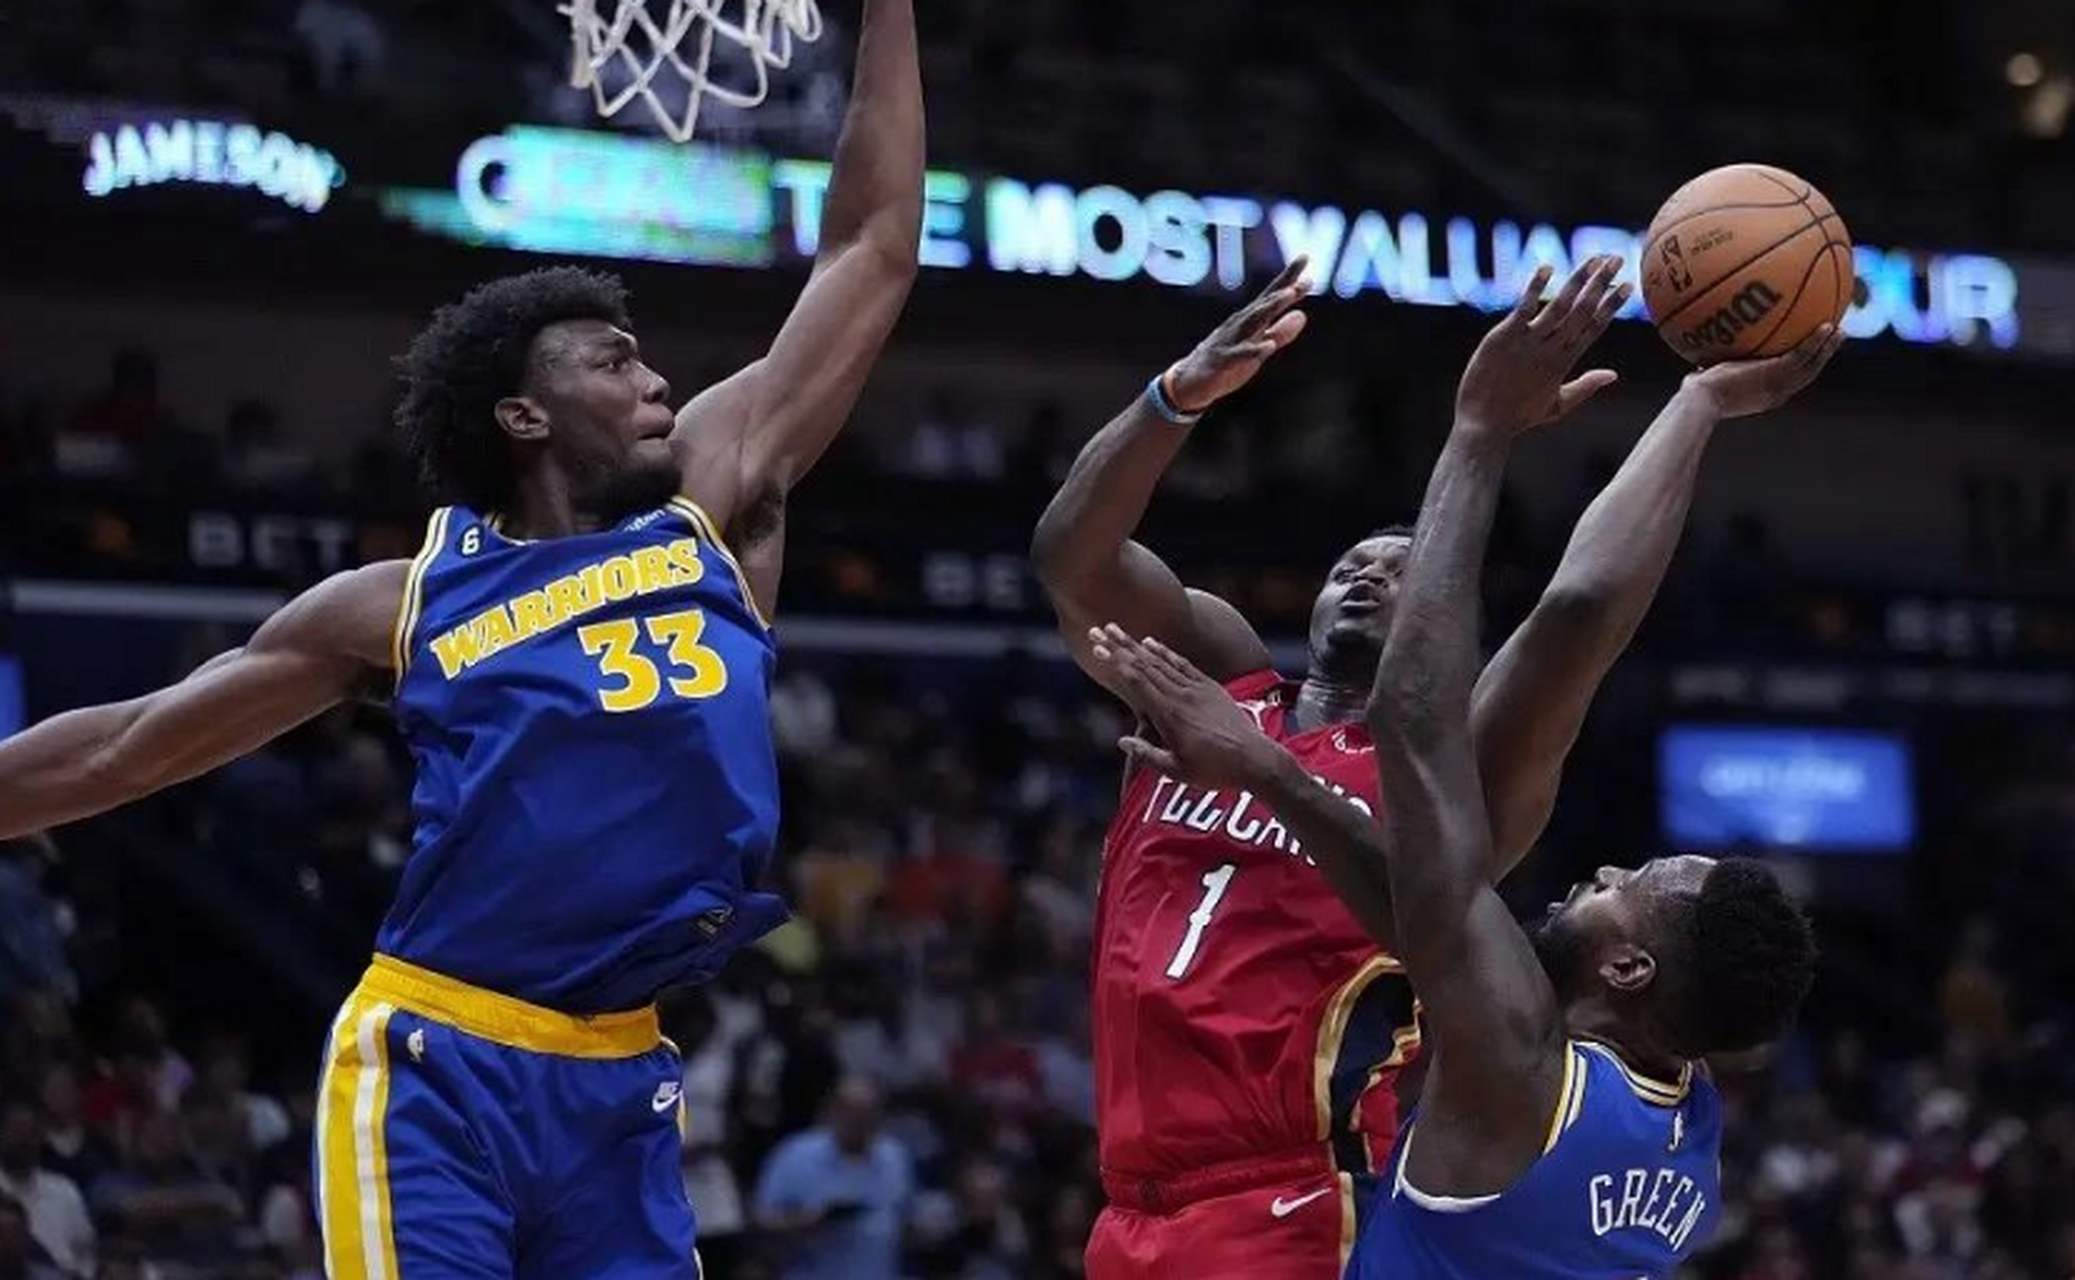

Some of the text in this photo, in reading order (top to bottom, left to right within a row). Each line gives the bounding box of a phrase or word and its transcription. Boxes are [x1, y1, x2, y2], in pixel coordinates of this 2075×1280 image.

[774, 158, 972, 270] TE
[985, 176, 1264, 291] MOST
[1838, 243, 2020, 350] OUR
[461, 526, 480, 556] 6
[429, 537, 704, 681] WARRIORS
[577, 609, 729, 713] 33
[1165, 863, 1236, 979] 1
[1589, 1167, 1706, 1252] GREEN
